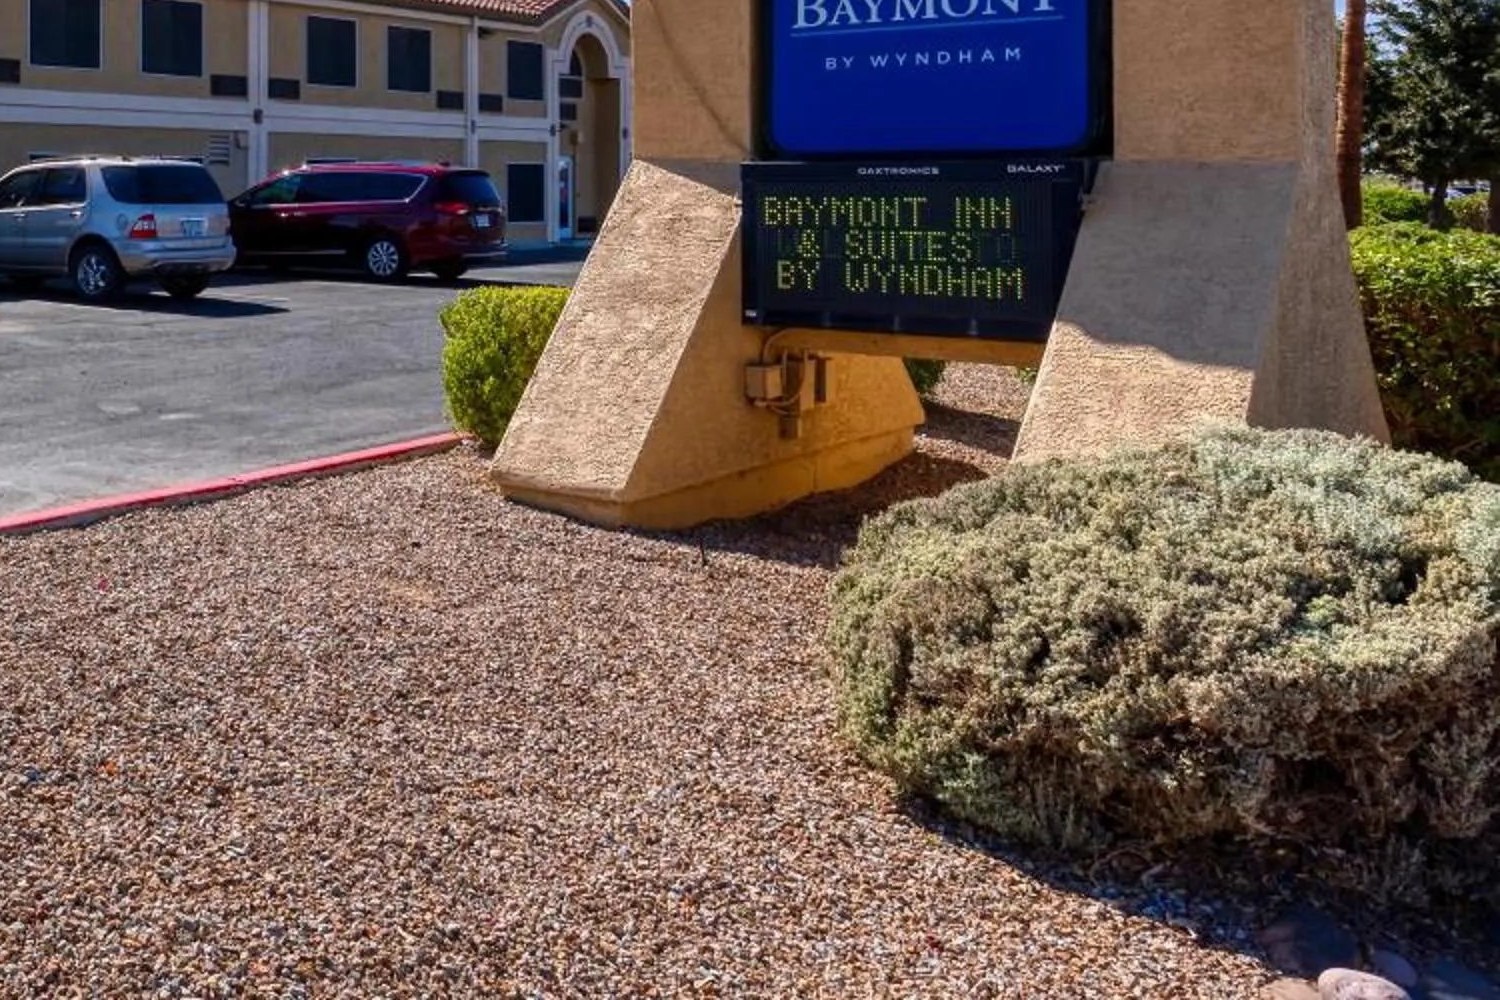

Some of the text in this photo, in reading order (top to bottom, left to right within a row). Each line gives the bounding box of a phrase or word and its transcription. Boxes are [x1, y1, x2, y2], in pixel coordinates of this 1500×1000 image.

[825, 47, 1022, 71] BY WYNDHAM
[764, 196, 1012, 229] BAYMONT INN
[799, 229, 972, 262] & SUITES
[776, 260, 1026, 300] BY WYNDHAM
